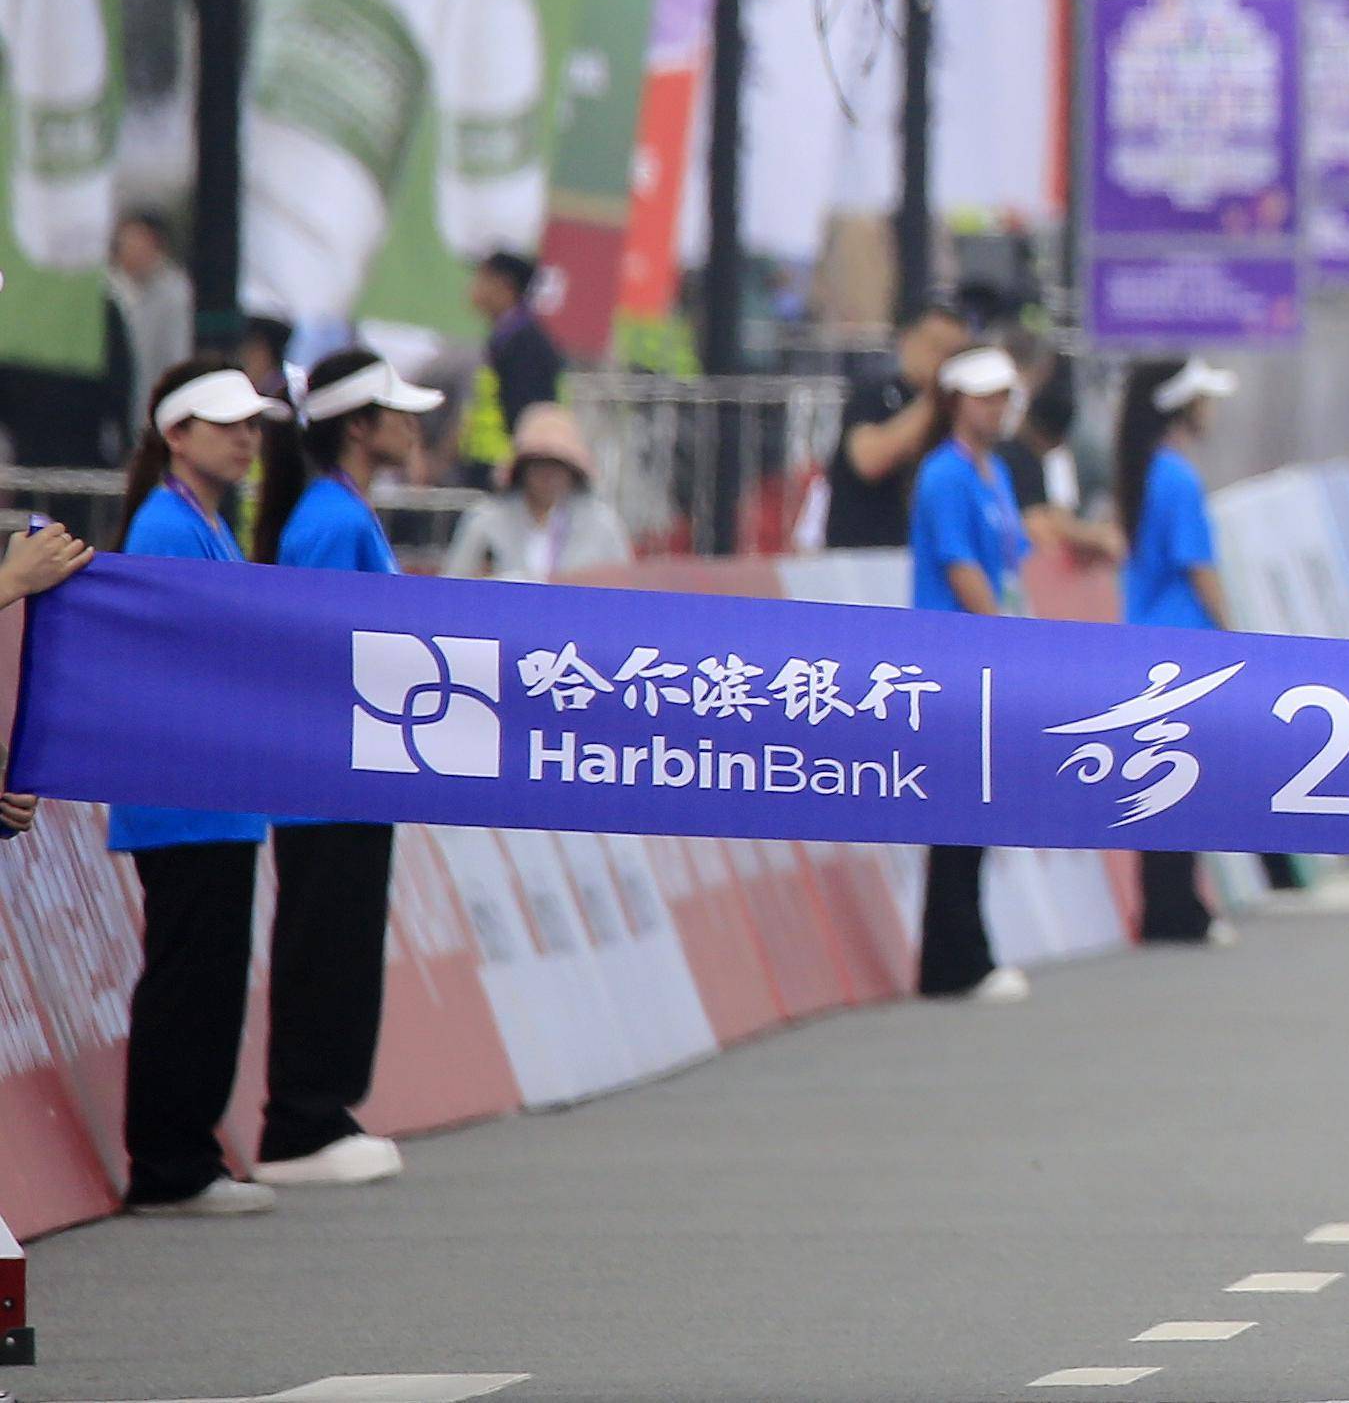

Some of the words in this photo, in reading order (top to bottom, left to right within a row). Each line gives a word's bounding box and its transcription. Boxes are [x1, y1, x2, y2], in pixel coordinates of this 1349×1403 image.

[516, 640, 942, 733] 哈尔滨银行
[528, 729, 929, 801] HarbinBank
